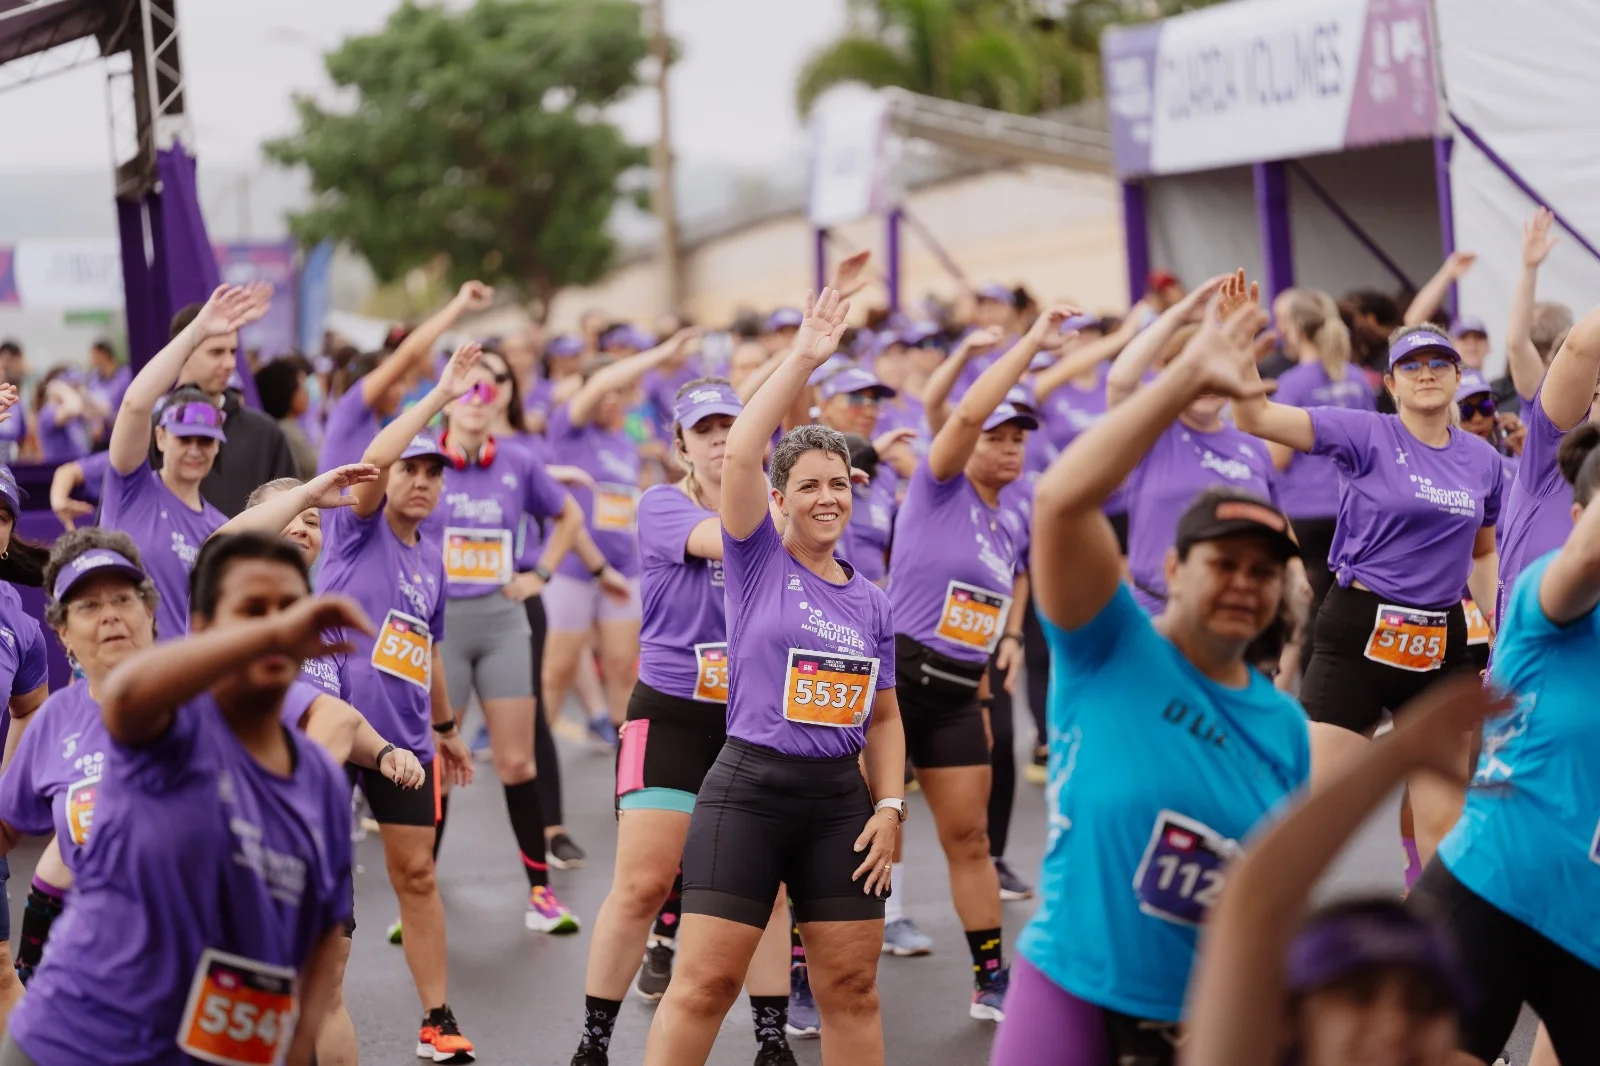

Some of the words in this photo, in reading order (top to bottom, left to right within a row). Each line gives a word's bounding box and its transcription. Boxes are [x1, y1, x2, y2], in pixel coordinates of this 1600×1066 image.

[1420, 484, 1469, 499] CIRCUITO
[808, 614, 859, 638] CIRCUITO
[948, 605, 995, 636] 5379
[801, 623, 818, 633] MAIS
[817, 628, 864, 650] MULHER
[1378, 630, 1440, 657] 5185
[803, 664, 813, 672] 5K
[794, 679, 863, 709] 5537
